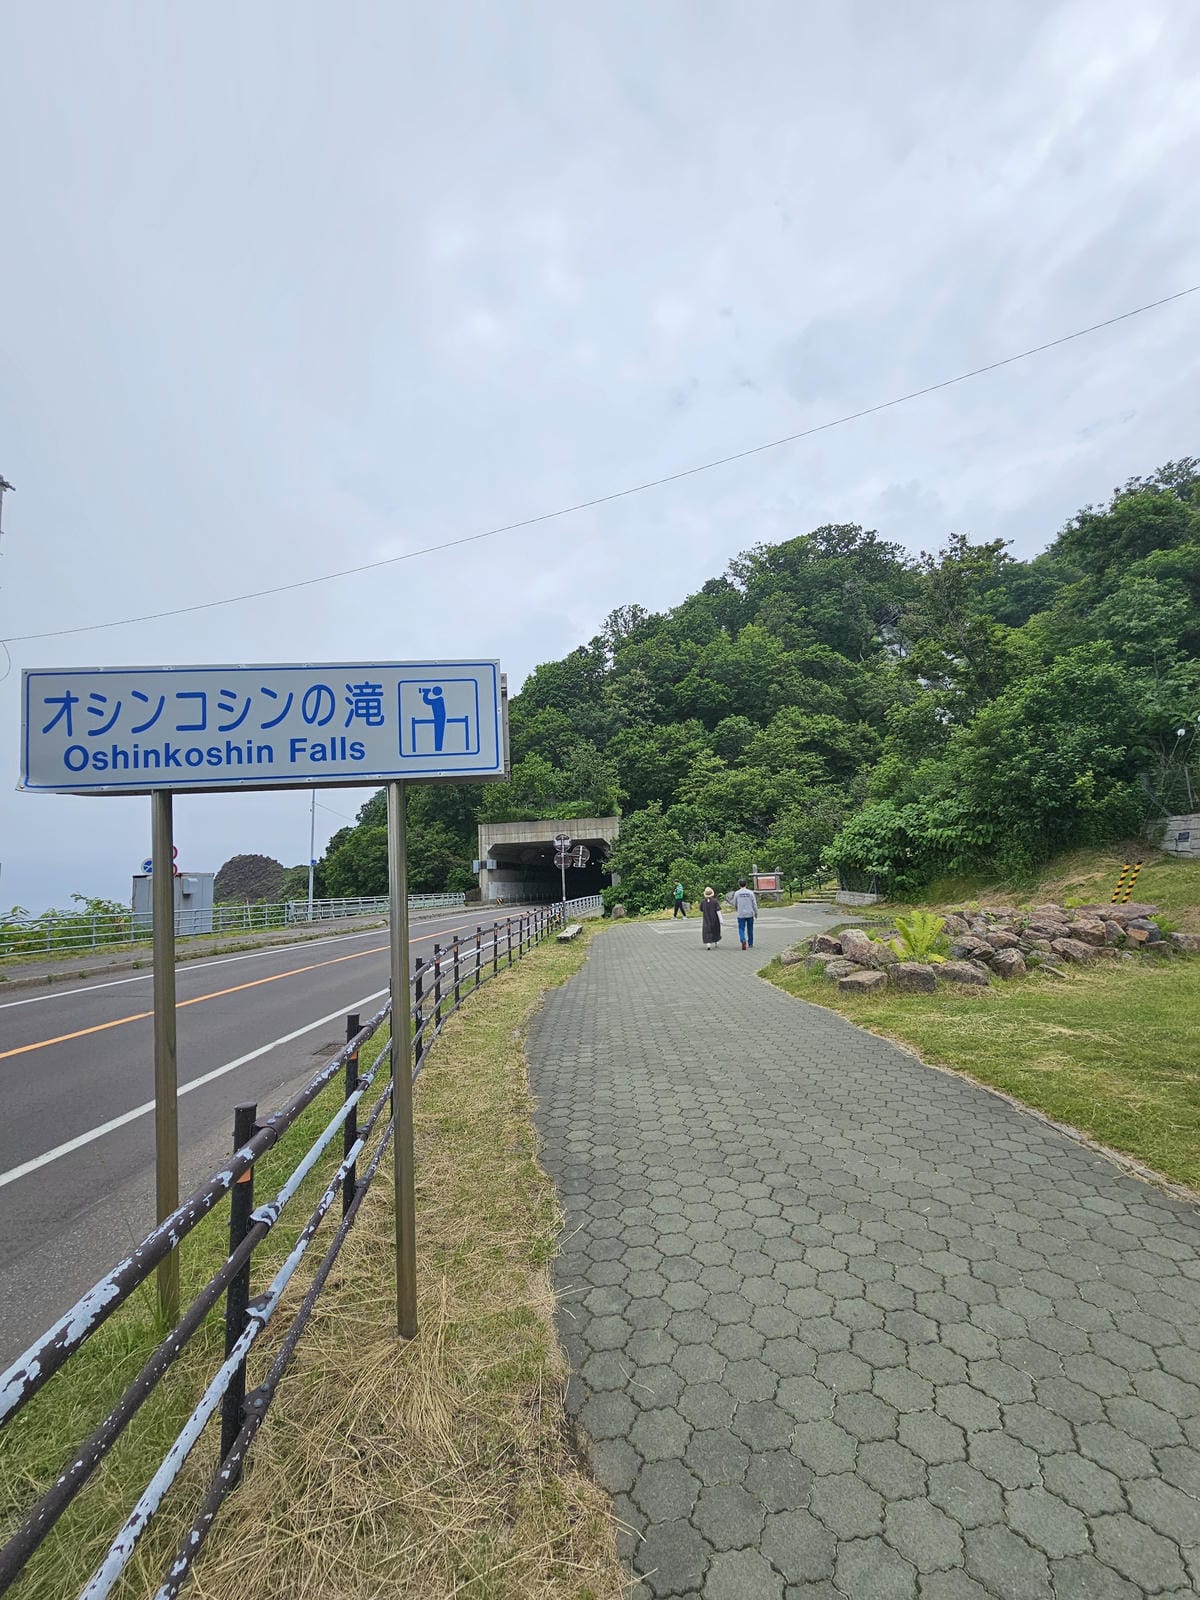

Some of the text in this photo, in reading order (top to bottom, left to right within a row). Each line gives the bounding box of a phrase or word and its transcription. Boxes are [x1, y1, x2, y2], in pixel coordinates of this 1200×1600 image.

[41, 681, 385, 737] オシンコシンの滝
[63, 736, 367, 772] Oshinkoshin Falls
